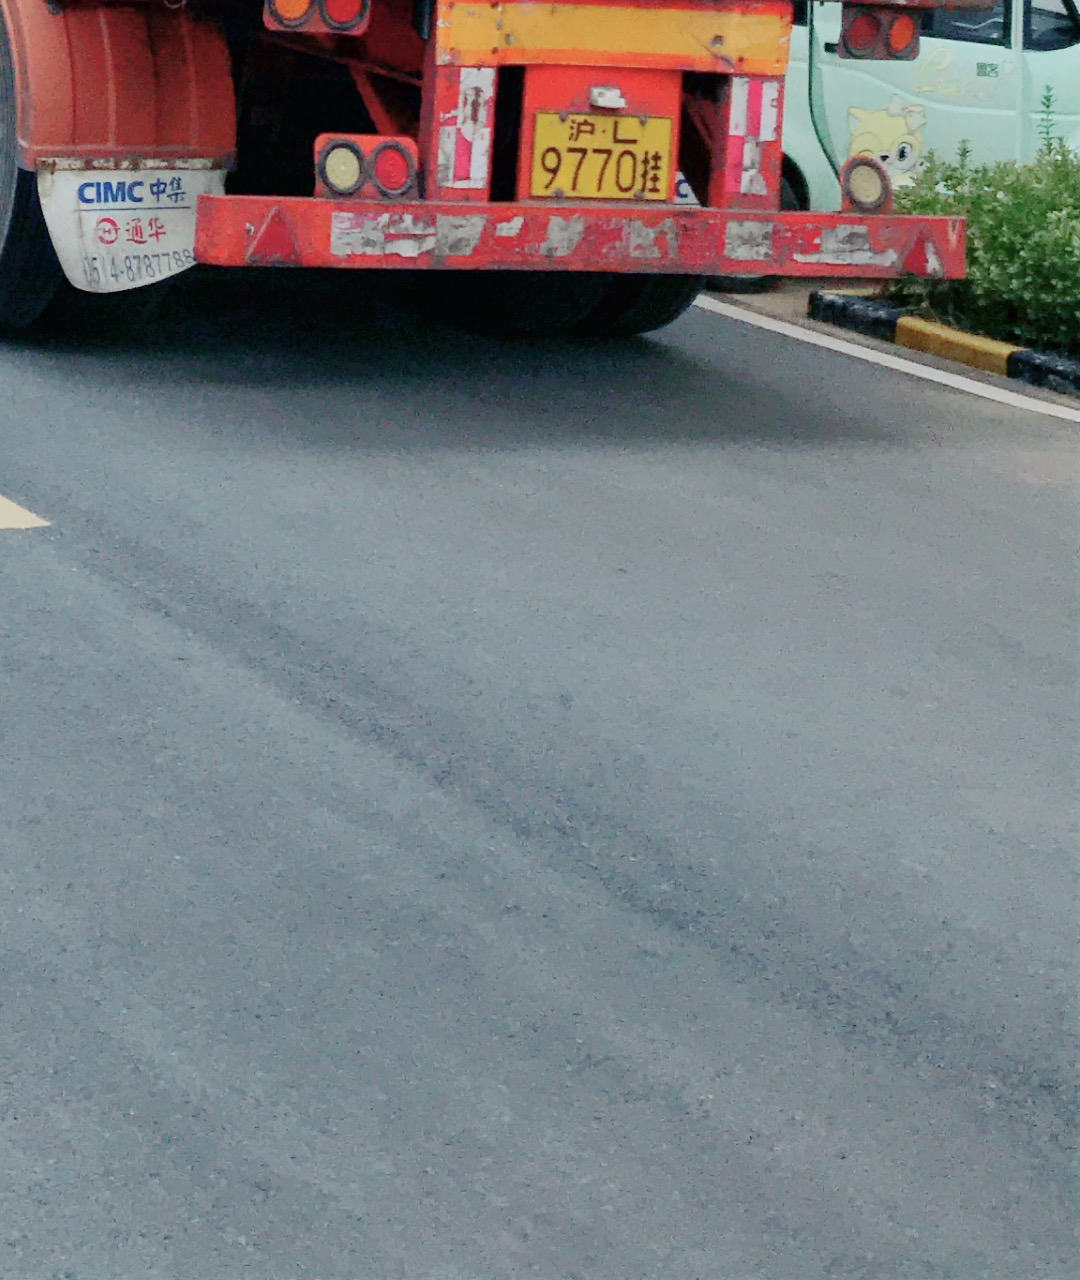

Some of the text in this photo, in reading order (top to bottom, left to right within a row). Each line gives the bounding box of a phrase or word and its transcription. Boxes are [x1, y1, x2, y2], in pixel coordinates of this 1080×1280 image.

[76, 176, 187, 204] CIMC 中集
[125, 216, 167, 245] 通华
